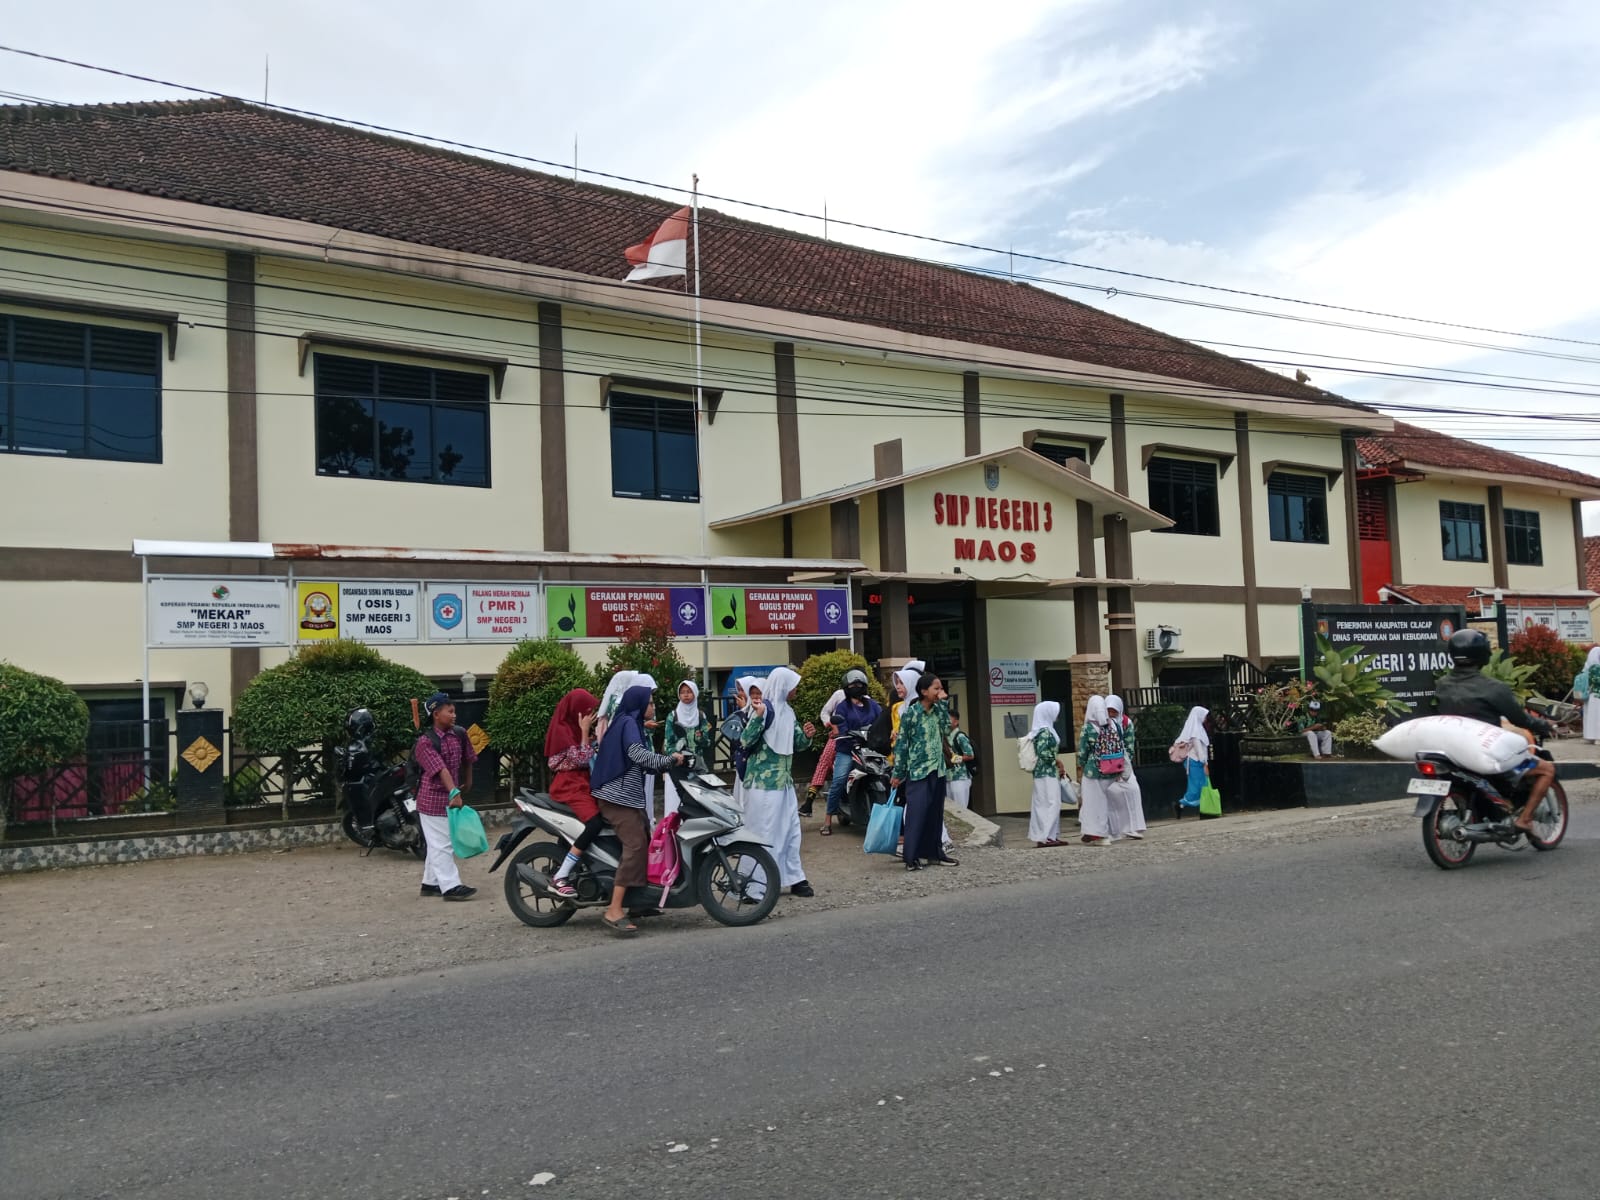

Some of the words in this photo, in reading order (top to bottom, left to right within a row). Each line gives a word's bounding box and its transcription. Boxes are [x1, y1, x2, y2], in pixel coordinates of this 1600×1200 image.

[934, 492, 970, 526] SMP
[975, 497, 1039, 532] NEGERI
[1044, 502, 1052, 532] 3
[954, 538, 1036, 563] MAOS
[590, 592, 626, 600] GERAKAN
[628, 592, 665, 601] PRAMUKA
[365, 600, 392, 608] OSIS
[488, 601, 516, 610] PMR
[602, 603, 628, 611] GUGUS
[760, 603, 781, 611] GUGUS
[191, 609, 251, 620] "MEKAR"
[346, 614, 366, 622] SMP
[368, 614, 403, 622] NEGERI
[406, 614, 411, 622] 3
[177, 621, 195, 629] SMP
[1336, 621, 1372, 630] PEMERINTAH
[366, 626, 392, 634] MAOS
[1408, 653, 1416, 671] 3
